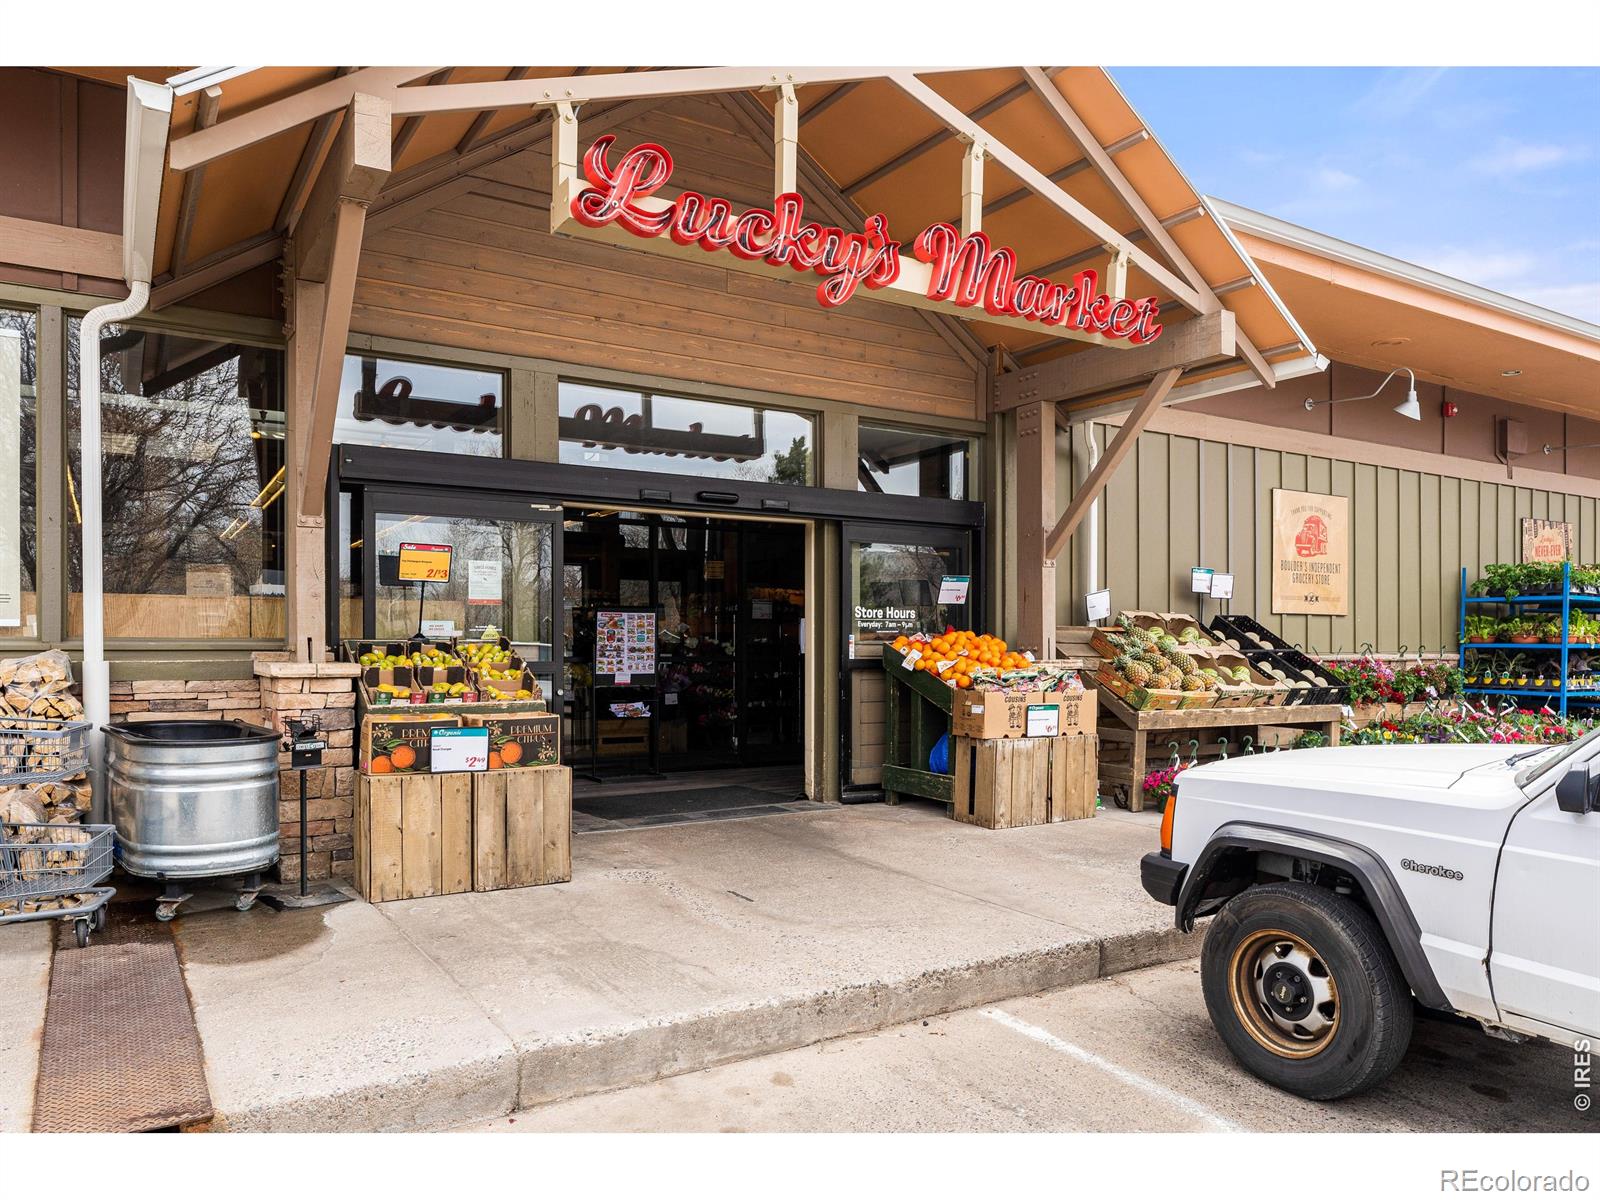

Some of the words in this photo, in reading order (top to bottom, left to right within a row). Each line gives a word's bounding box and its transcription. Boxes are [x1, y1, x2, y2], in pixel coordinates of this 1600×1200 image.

[570, 134, 902, 308] Lucky's
[915, 222, 1162, 344] Market
[1280, 560, 1307, 572] BOULDER'S
[1309, 562, 1341, 575] INDEPENDENT
[1292, 572, 1314, 584] GROCERY
[1315, 574, 1330, 586] STORE
[854, 605, 883, 618] Store
[886, 606, 916, 619] Hours
[857, 620, 883, 629] Everyday:
[1063, 694, 1083, 702] COUSINS
[402, 728, 431, 738] PREM
[438, 729, 462, 737] Organic
[510, 724, 552, 734] PREMIUM
[516, 734, 546, 744] CITRUS
[1400, 858, 1464, 881] Cherokee
